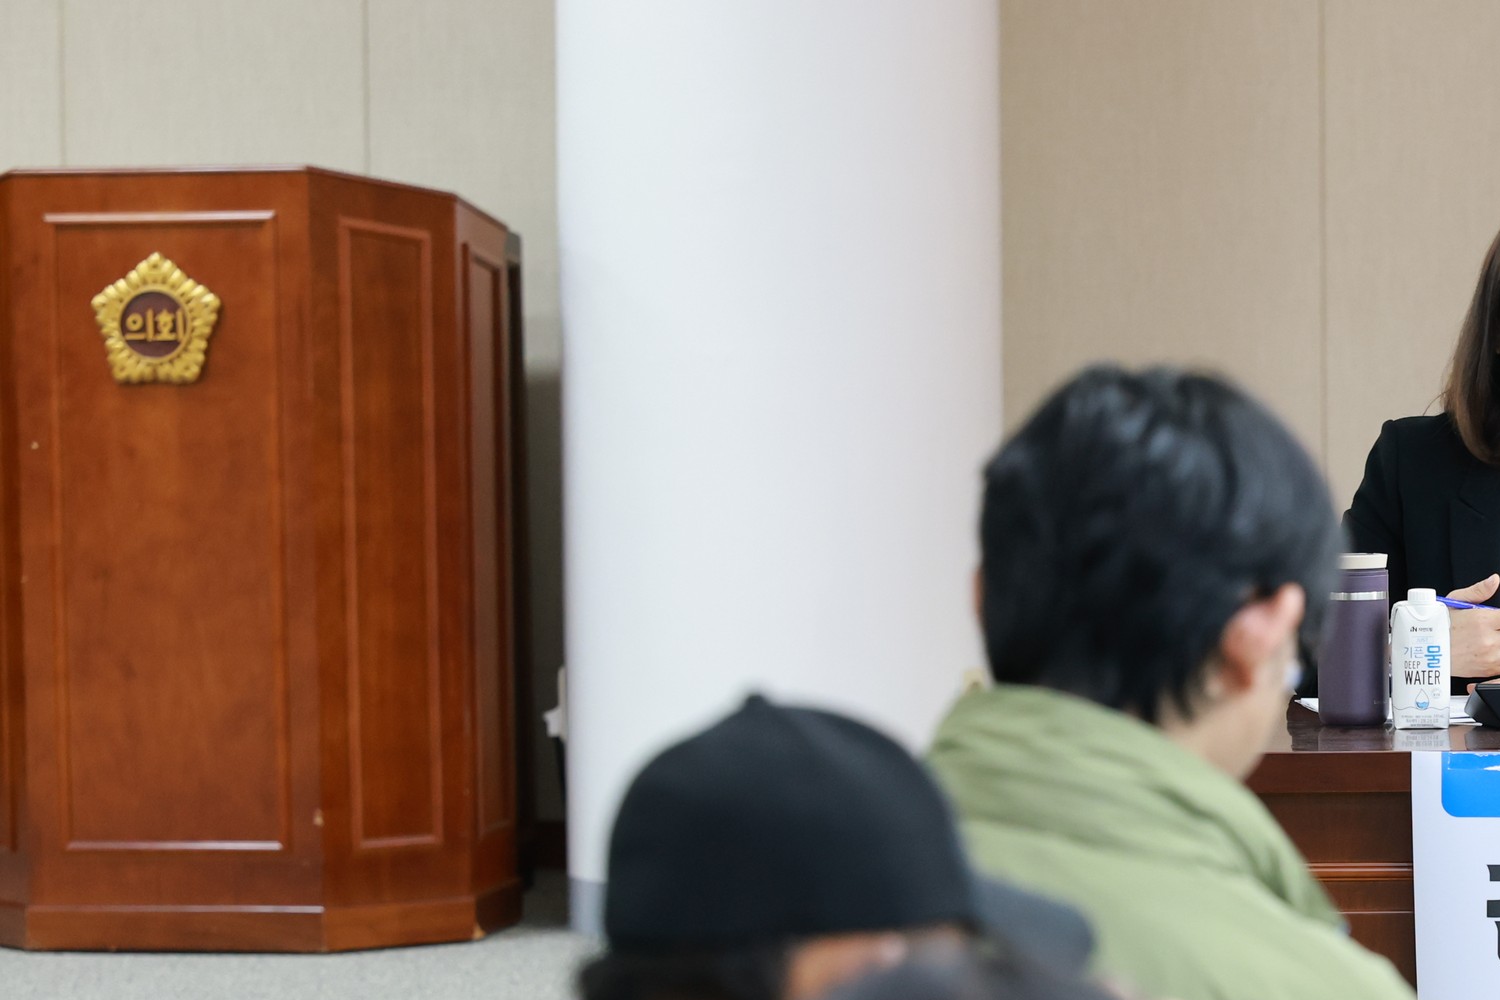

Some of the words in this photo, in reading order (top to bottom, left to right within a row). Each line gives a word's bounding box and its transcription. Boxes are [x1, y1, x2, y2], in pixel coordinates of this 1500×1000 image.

[125, 307, 185, 342] 의회
[1403, 646, 1424, 659] 기픈
[1424, 645, 1443, 669] 물
[1404, 660, 1421, 669] DEEP
[1404, 669, 1441, 686] WATER
